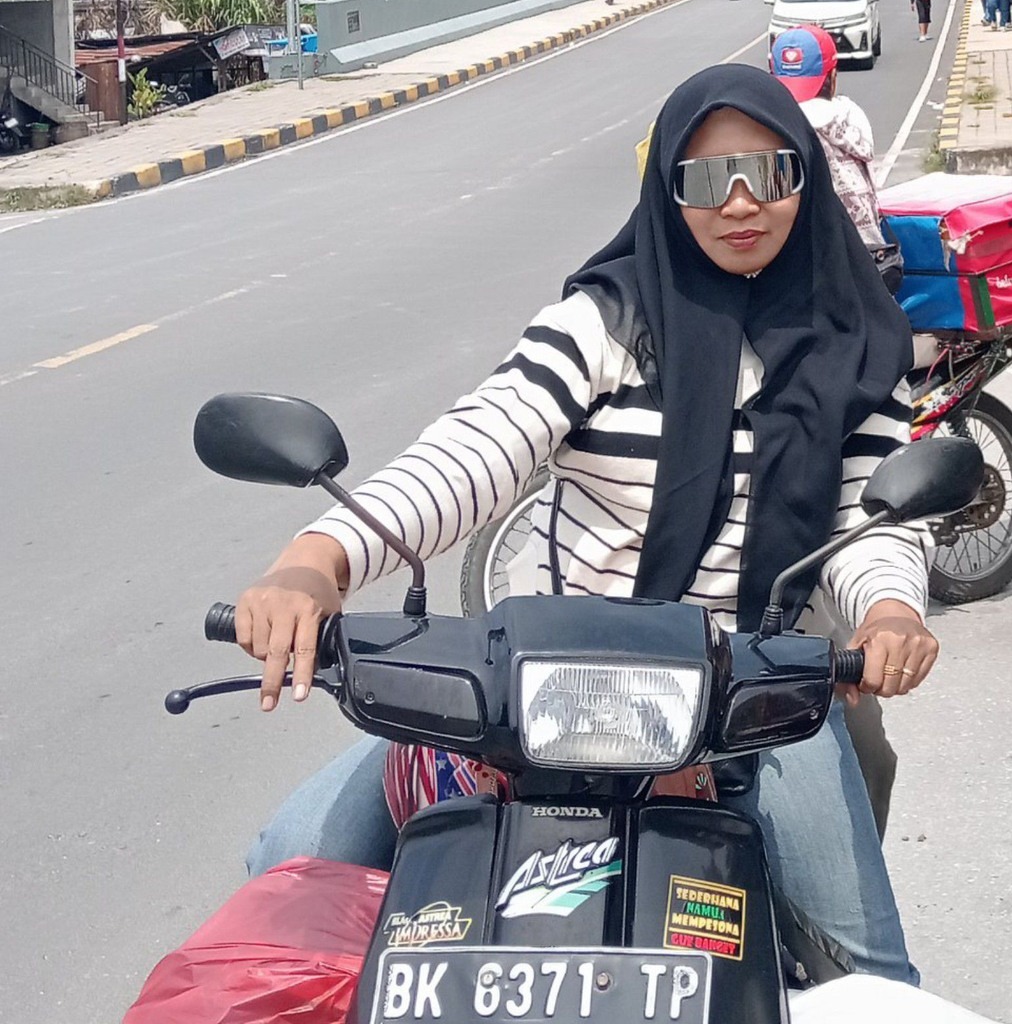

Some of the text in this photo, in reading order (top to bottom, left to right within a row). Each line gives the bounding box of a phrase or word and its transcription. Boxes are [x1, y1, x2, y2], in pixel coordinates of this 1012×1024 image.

[532, 806, 603, 818] HONDA
[494, 837, 620, 910] Astrea
[676, 887, 740, 911] SEDERHANA
[671, 912, 740, 936] MEMPESONA
[671, 933, 694, 948] GUE
[384, 962, 448, 1018] BK
[474, 963, 594, 1018] 6371
[641, 964, 699, 1019] TP
